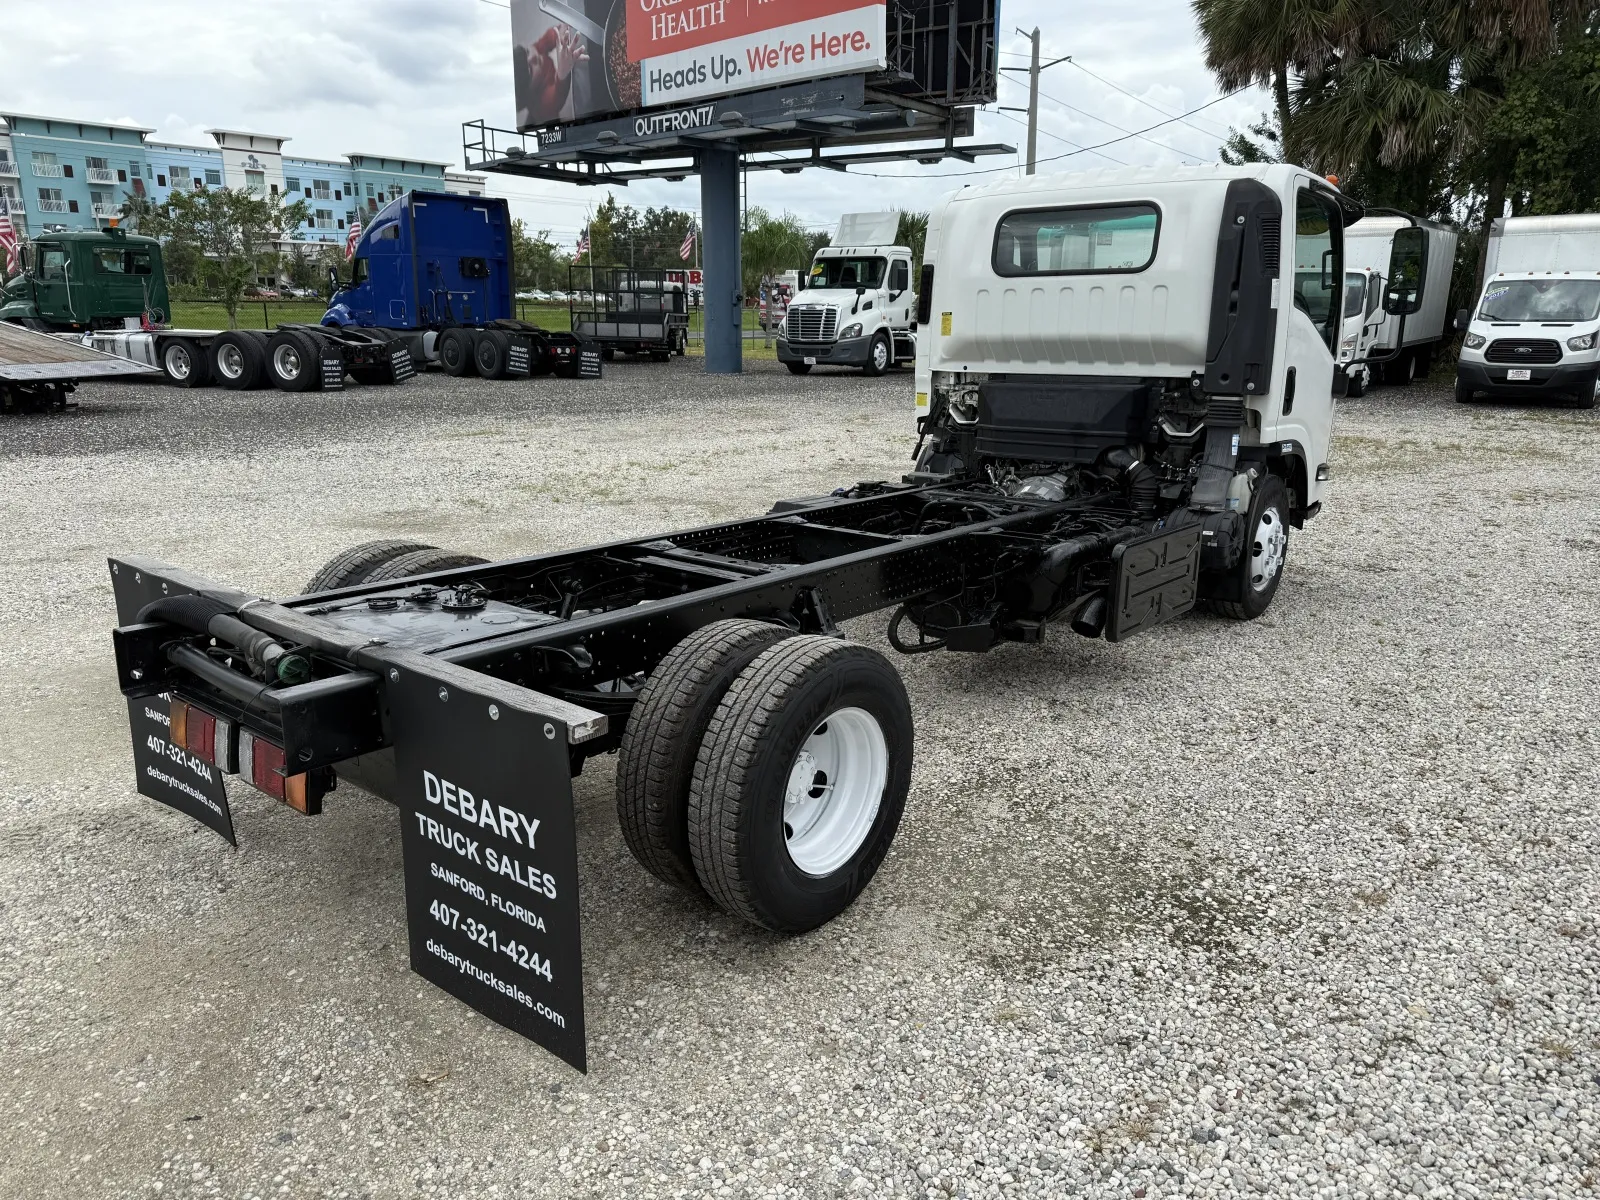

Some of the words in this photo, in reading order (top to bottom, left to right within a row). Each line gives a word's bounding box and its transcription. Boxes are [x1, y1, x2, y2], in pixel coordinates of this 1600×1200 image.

[651, 1, 726, 41] HEALTH
[650, 60, 707, 93] Heads
[711, 54, 742, 84] Up.
[746, 40, 804, 73] We're
[810, 30, 871, 61] Here.
[541, 131, 562, 144] 7233W
[147, 735, 213, 784] 407-321-4244
[147, 765, 223, 817] debarytrucksales.com
[423, 770, 541, 850] DEBARY
[415, 812, 481, 865] TRUCK
[485, 848, 557, 899] SALES
[430, 862, 489, 906] SANFORD,
[491, 893, 546, 933] FLORIDA
[429, 899, 553, 982] 407-321-4244
[426, 939, 566, 1029] debarytrucksales.com
